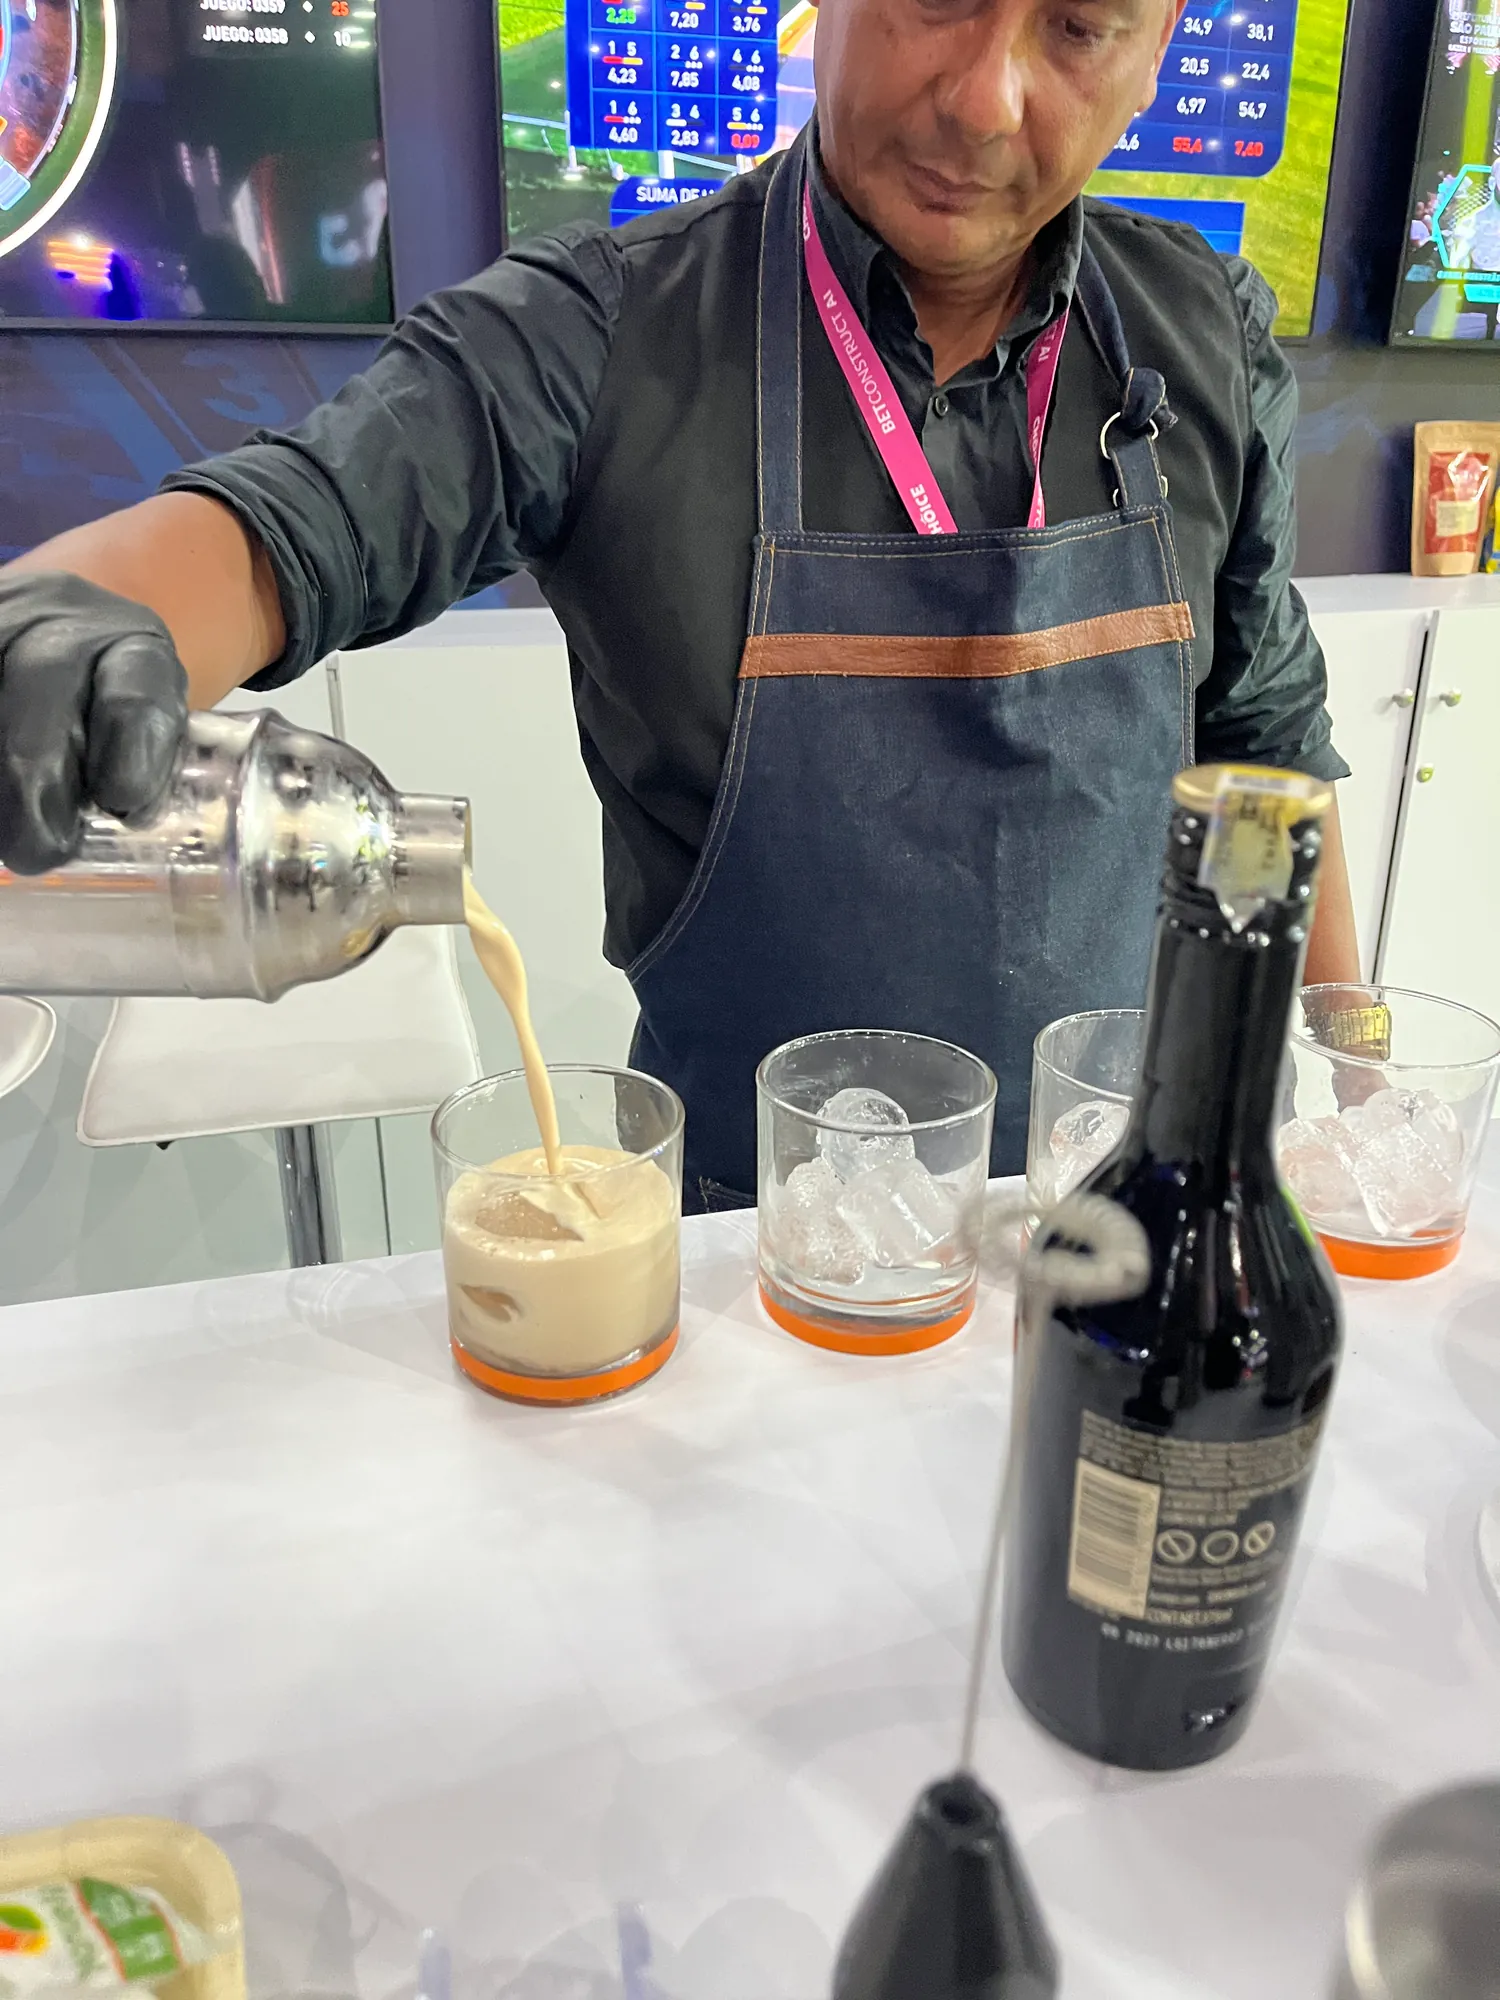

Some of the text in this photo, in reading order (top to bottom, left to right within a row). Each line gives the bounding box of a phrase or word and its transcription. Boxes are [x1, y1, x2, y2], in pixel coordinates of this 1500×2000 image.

[331, 1, 349, 17] 25
[670, 11, 699, 28] 7,20
[732, 16, 761, 33] 3,76
[1183, 17, 1213, 36] 34,9
[333, 30, 351, 47] 10
[1247, 23, 1274, 42] 38,1
[607, 40, 637, 56] 1 5
[671, 44, 700, 60] 2 6
[732, 48, 761, 64] 4 6
[1180, 57, 1209, 76] 20,5
[1241, 62, 1270, 81] 22,4
[607, 67, 637, 84] 4,23
[609, 99, 638, 116] 1 6
[671, 103, 700, 119] 3 4
[1176, 96, 1206, 115] 6,97
[1238, 101, 1267, 119] 54,7
[732, 107, 761, 123] 5 6
[608, 126, 638, 144] 4,60
[1113, 133, 1140, 151] 6,6
[636, 186, 679, 203] SUMA
[823, 289, 897, 435] BETCONSTRUCT AI
[910, 483, 945, 535] HOICE
